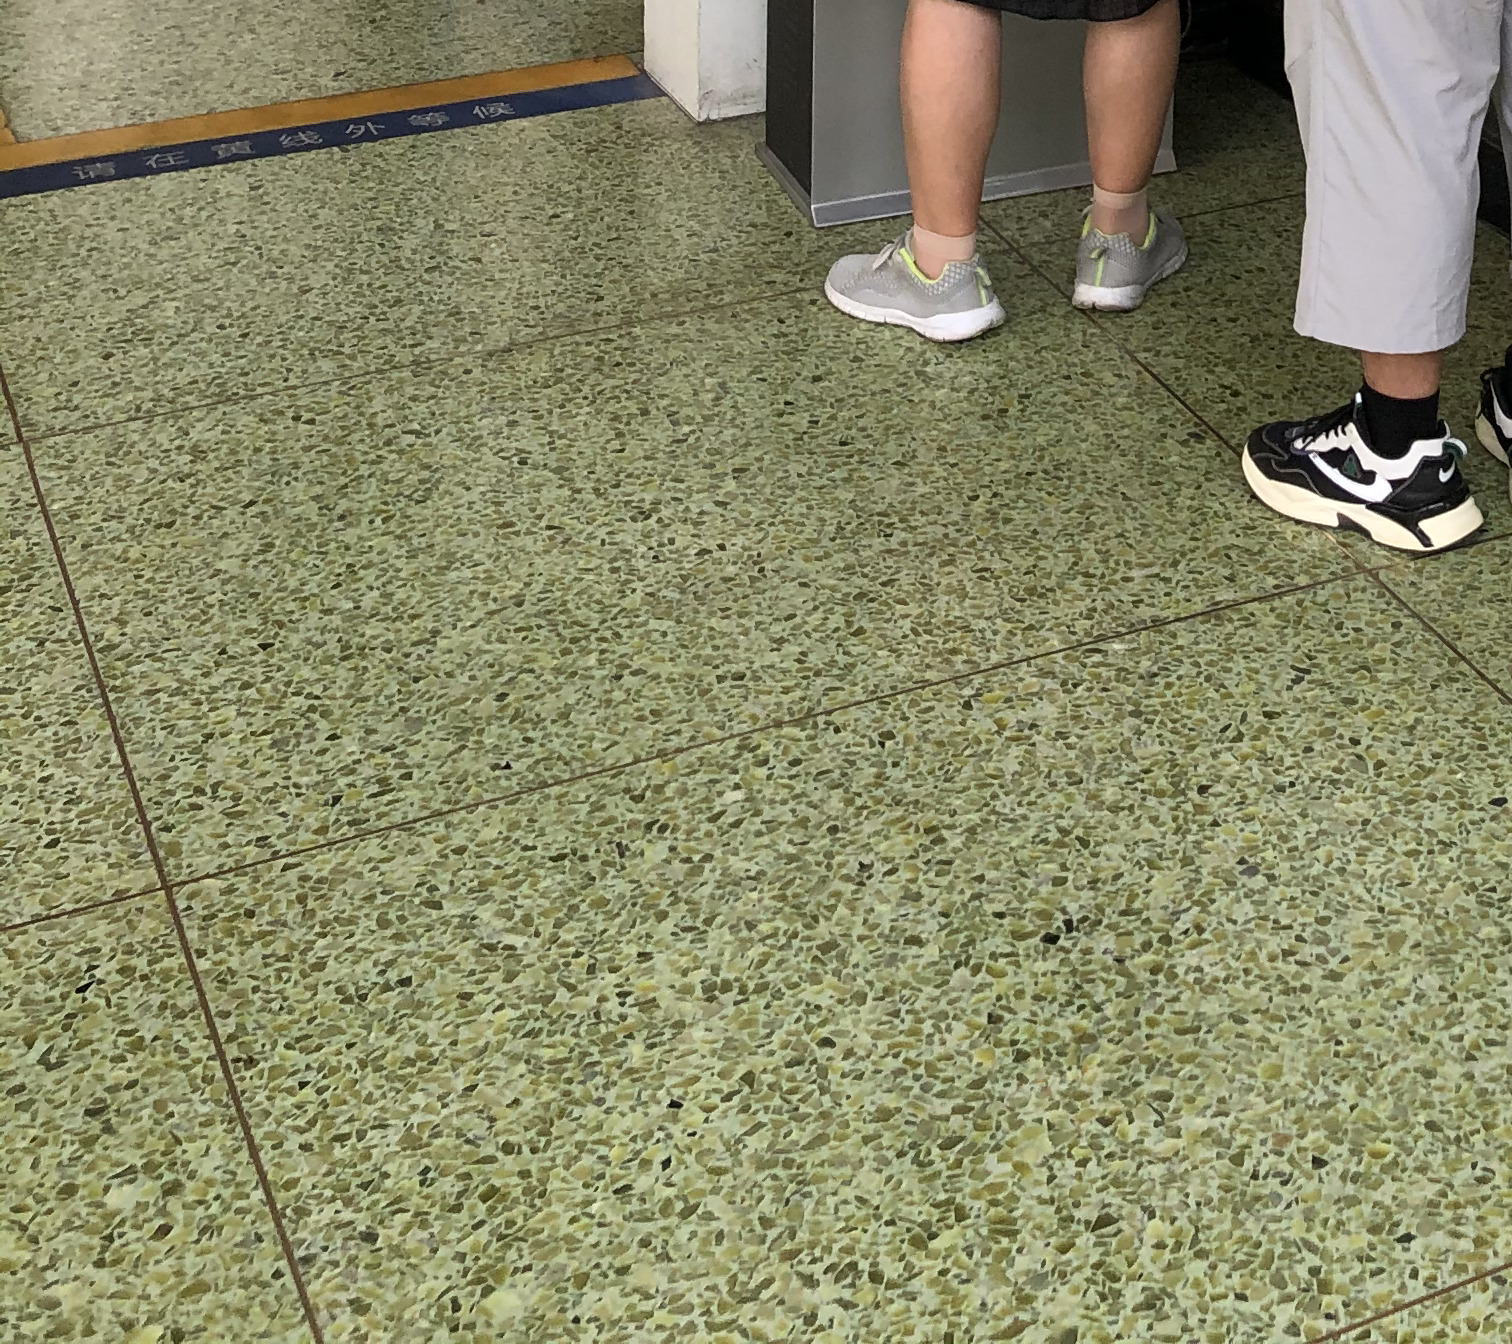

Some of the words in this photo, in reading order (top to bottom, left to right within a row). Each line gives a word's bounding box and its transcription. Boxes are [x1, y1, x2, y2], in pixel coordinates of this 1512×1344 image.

[72, 102, 516, 180] 请在黄线外等候
